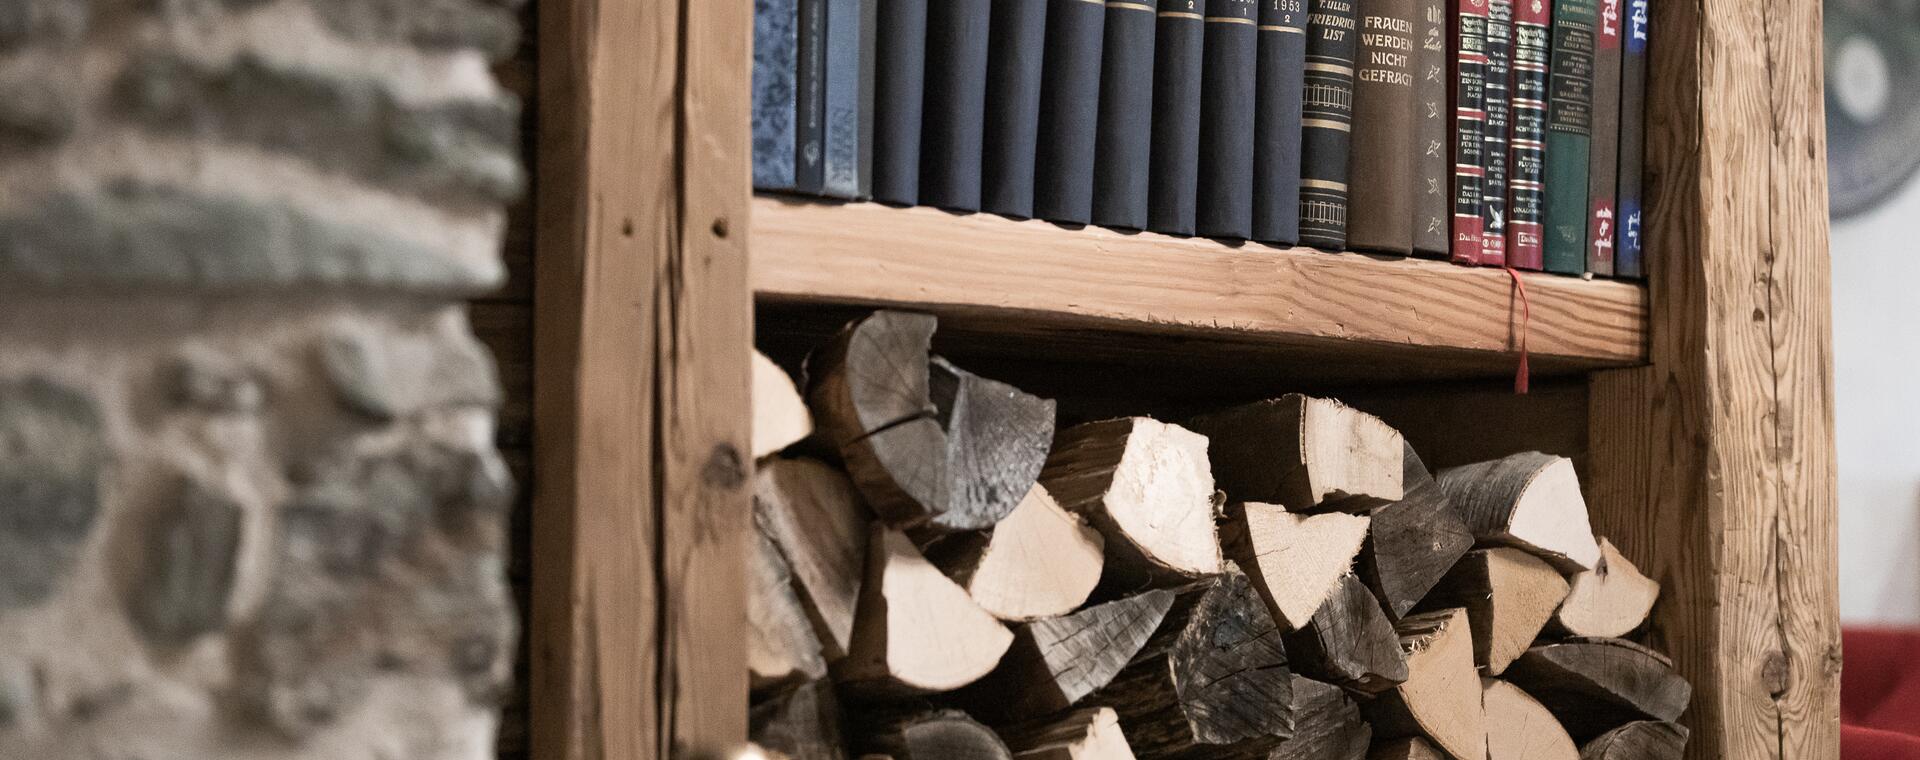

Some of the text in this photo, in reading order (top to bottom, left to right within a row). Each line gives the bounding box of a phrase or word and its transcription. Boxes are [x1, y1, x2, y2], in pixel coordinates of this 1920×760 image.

[1188, 0, 1194, 9] 2
[1273, 0, 1300, 13] 1953
[1284, 14, 1291, 23] 2
[1309, 13, 1356, 31] FRIEDRICH
[1364, 16, 1413, 34] FRAUEN
[1322, 28, 1345, 42] LIST
[1362, 33, 1413, 53] WERDEN
[1371, 51, 1408, 68] NICHT
[1358, 69, 1413, 88] GEFRAGT
